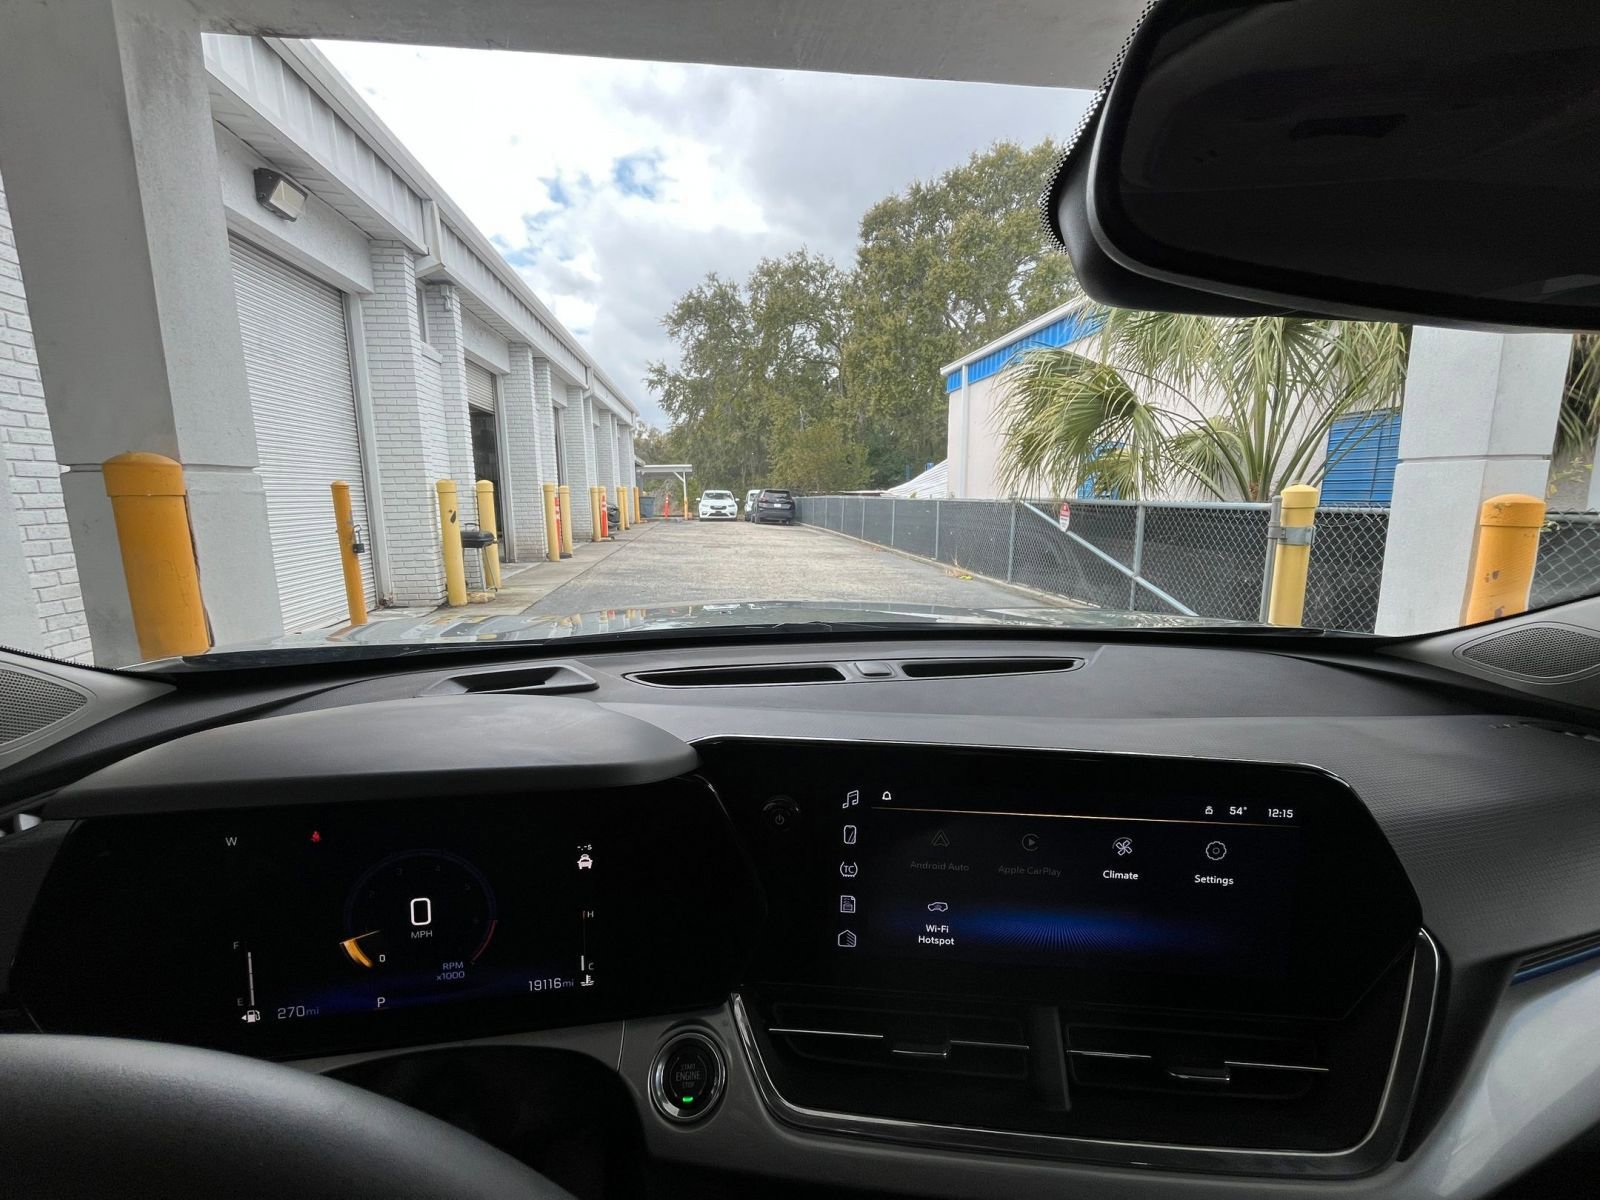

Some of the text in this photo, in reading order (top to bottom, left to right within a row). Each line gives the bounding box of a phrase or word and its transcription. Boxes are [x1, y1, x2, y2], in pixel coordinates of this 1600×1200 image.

[1268, 808, 1294, 819] 12:15
[225, 836, 238, 847] W
[843, 865, 855, 874] TC
[910, 860, 970, 872] Android Auto
[998, 864, 1063, 878] Apple CarPlay
[1102, 869, 1139, 880] Climate
[1194, 874, 1235, 887] Settings
[410, 897, 432, 926] 0
[587, 910, 595, 918] H
[925, 923, 950, 934] Wi-Fi
[410, 930, 433, 940] MPH
[918, 935, 955, 946] Hotspot
[233, 941, 240, 950] F
[379, 954, 386, 963] 0
[442, 961, 464, 971] RPM
[588, 962, 595, 971] C
[436, 971, 465, 981] x1000
[236, 997, 244, 1006] E
[377, 996, 386, 1008] P
[675, 1071, 701, 1082] ENGINE
